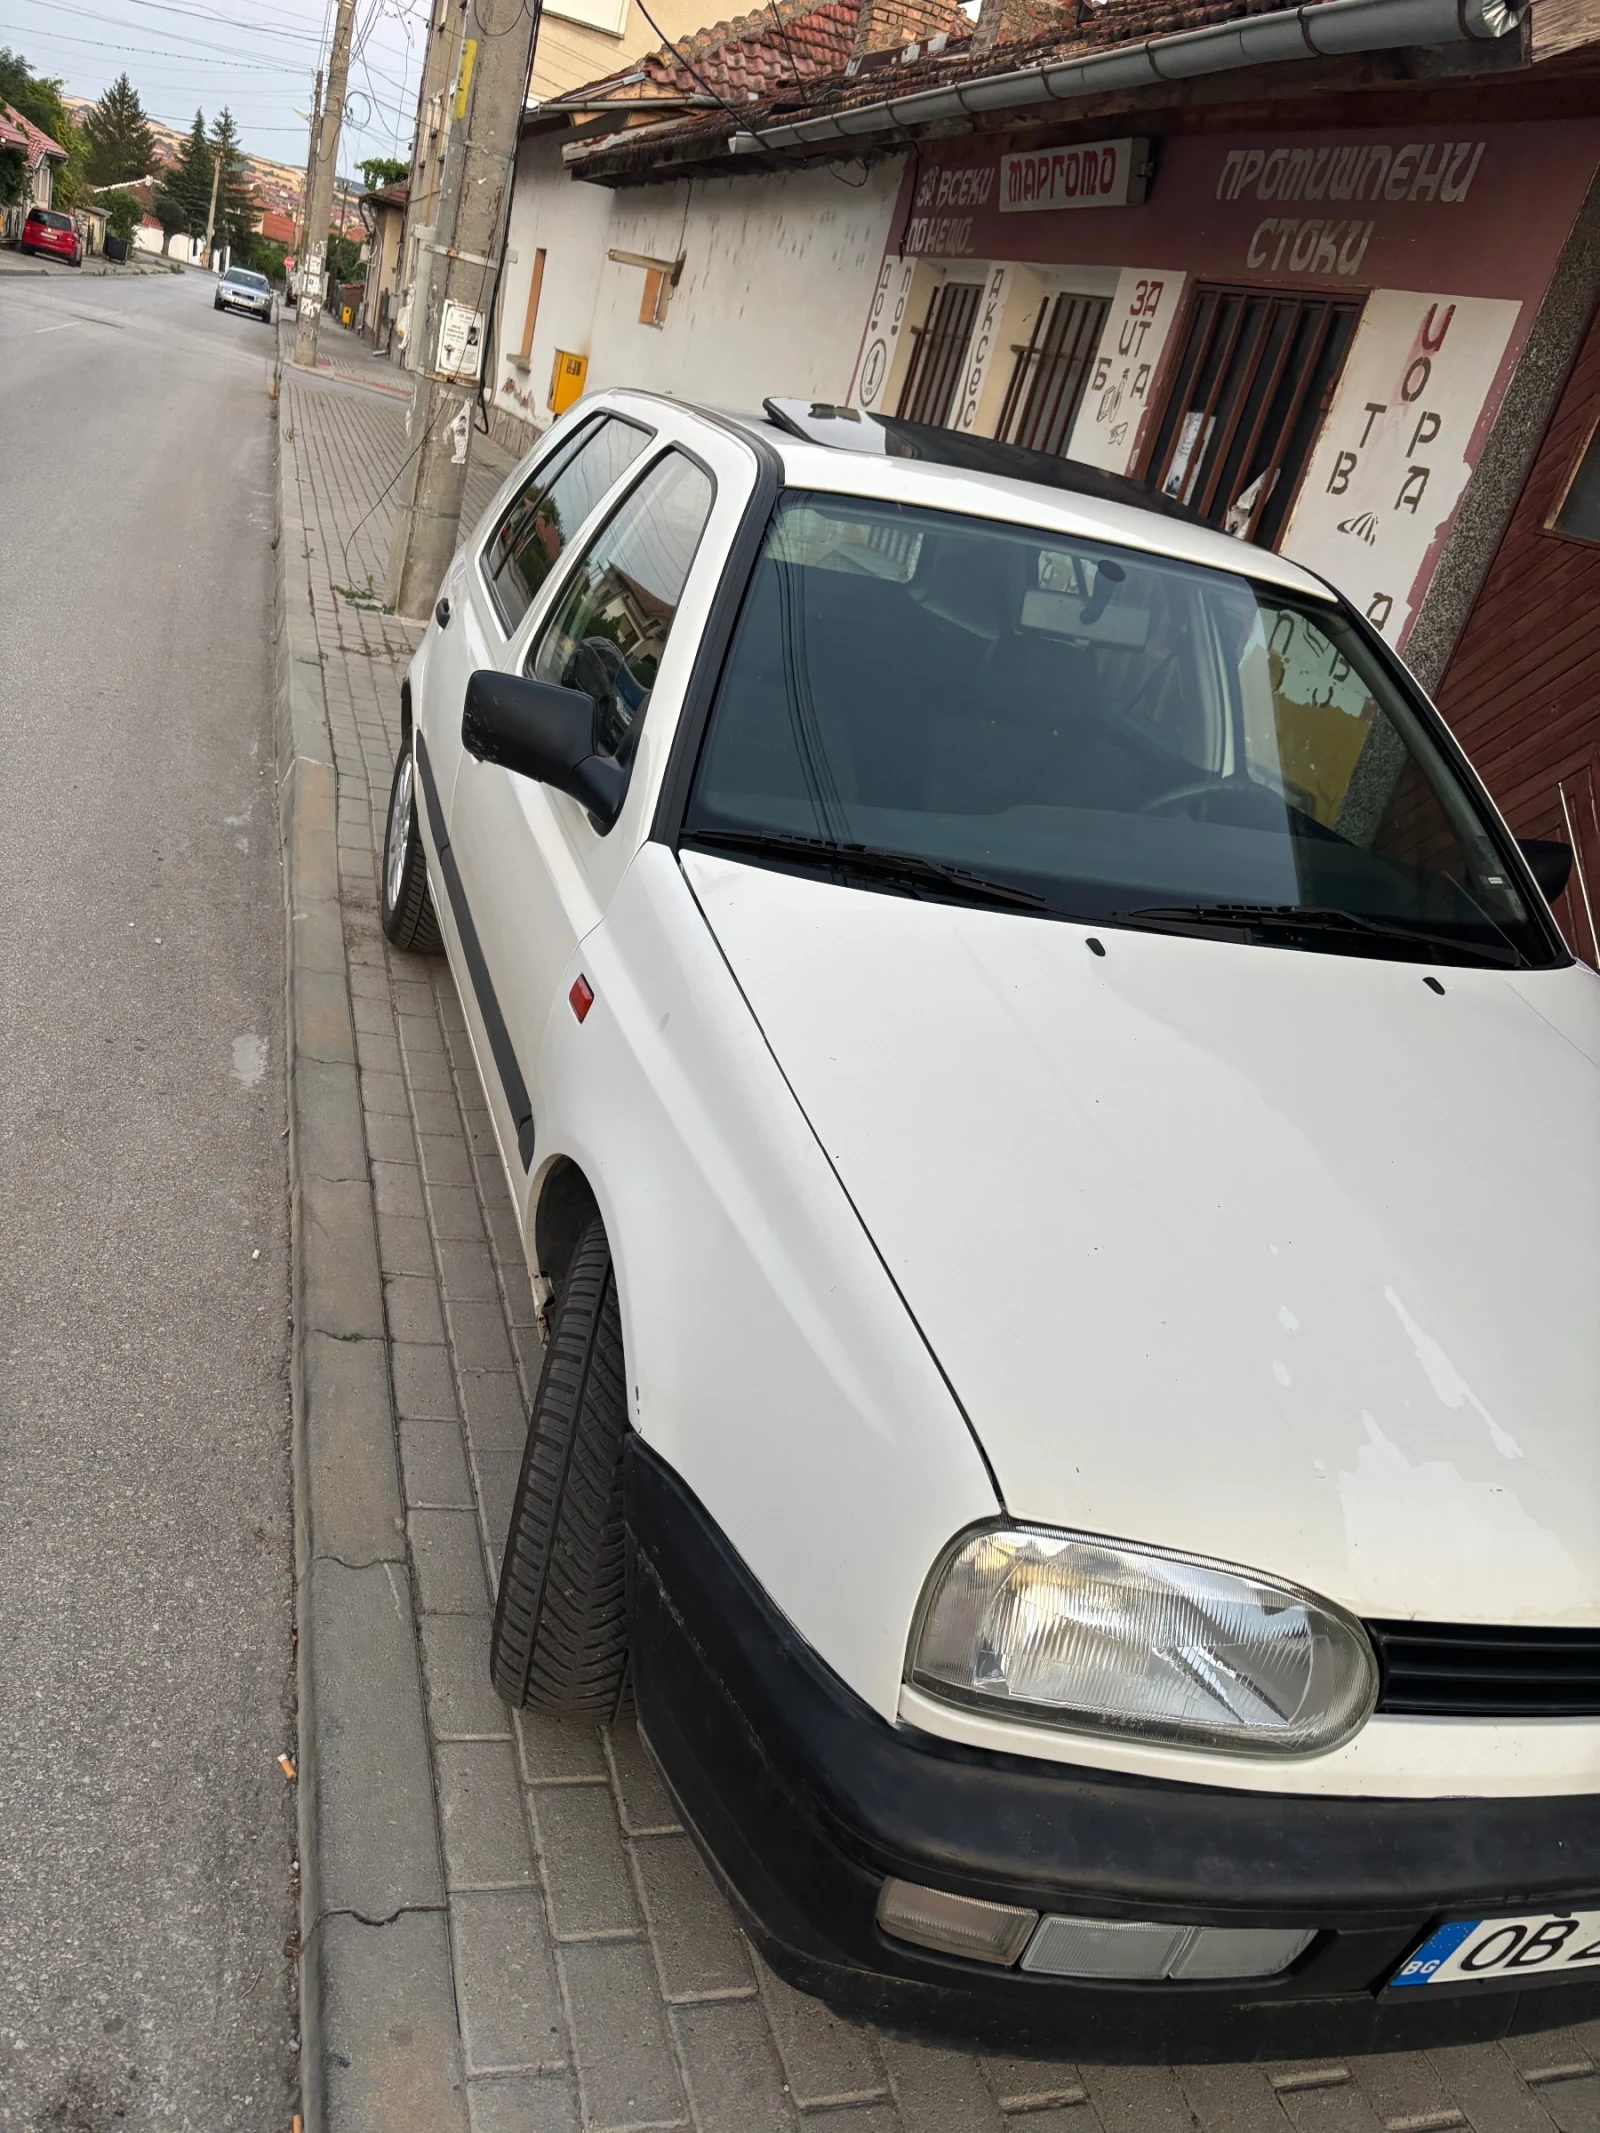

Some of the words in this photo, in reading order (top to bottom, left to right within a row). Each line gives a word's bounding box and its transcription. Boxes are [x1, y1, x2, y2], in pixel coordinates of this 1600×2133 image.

[936, 167, 996, 211] ВСЕКИ
[1008, 147, 1117, 203] МАРГОМО
[1215, 141, 1487, 203] ПРОМИШЛЕНИ
[906, 217, 928, 253] ПО
[1246, 217, 1376, 276] СТОКИ
[1129, 280, 1165, 318] ЗА
[1400, 1959, 1441, 1976] BG
